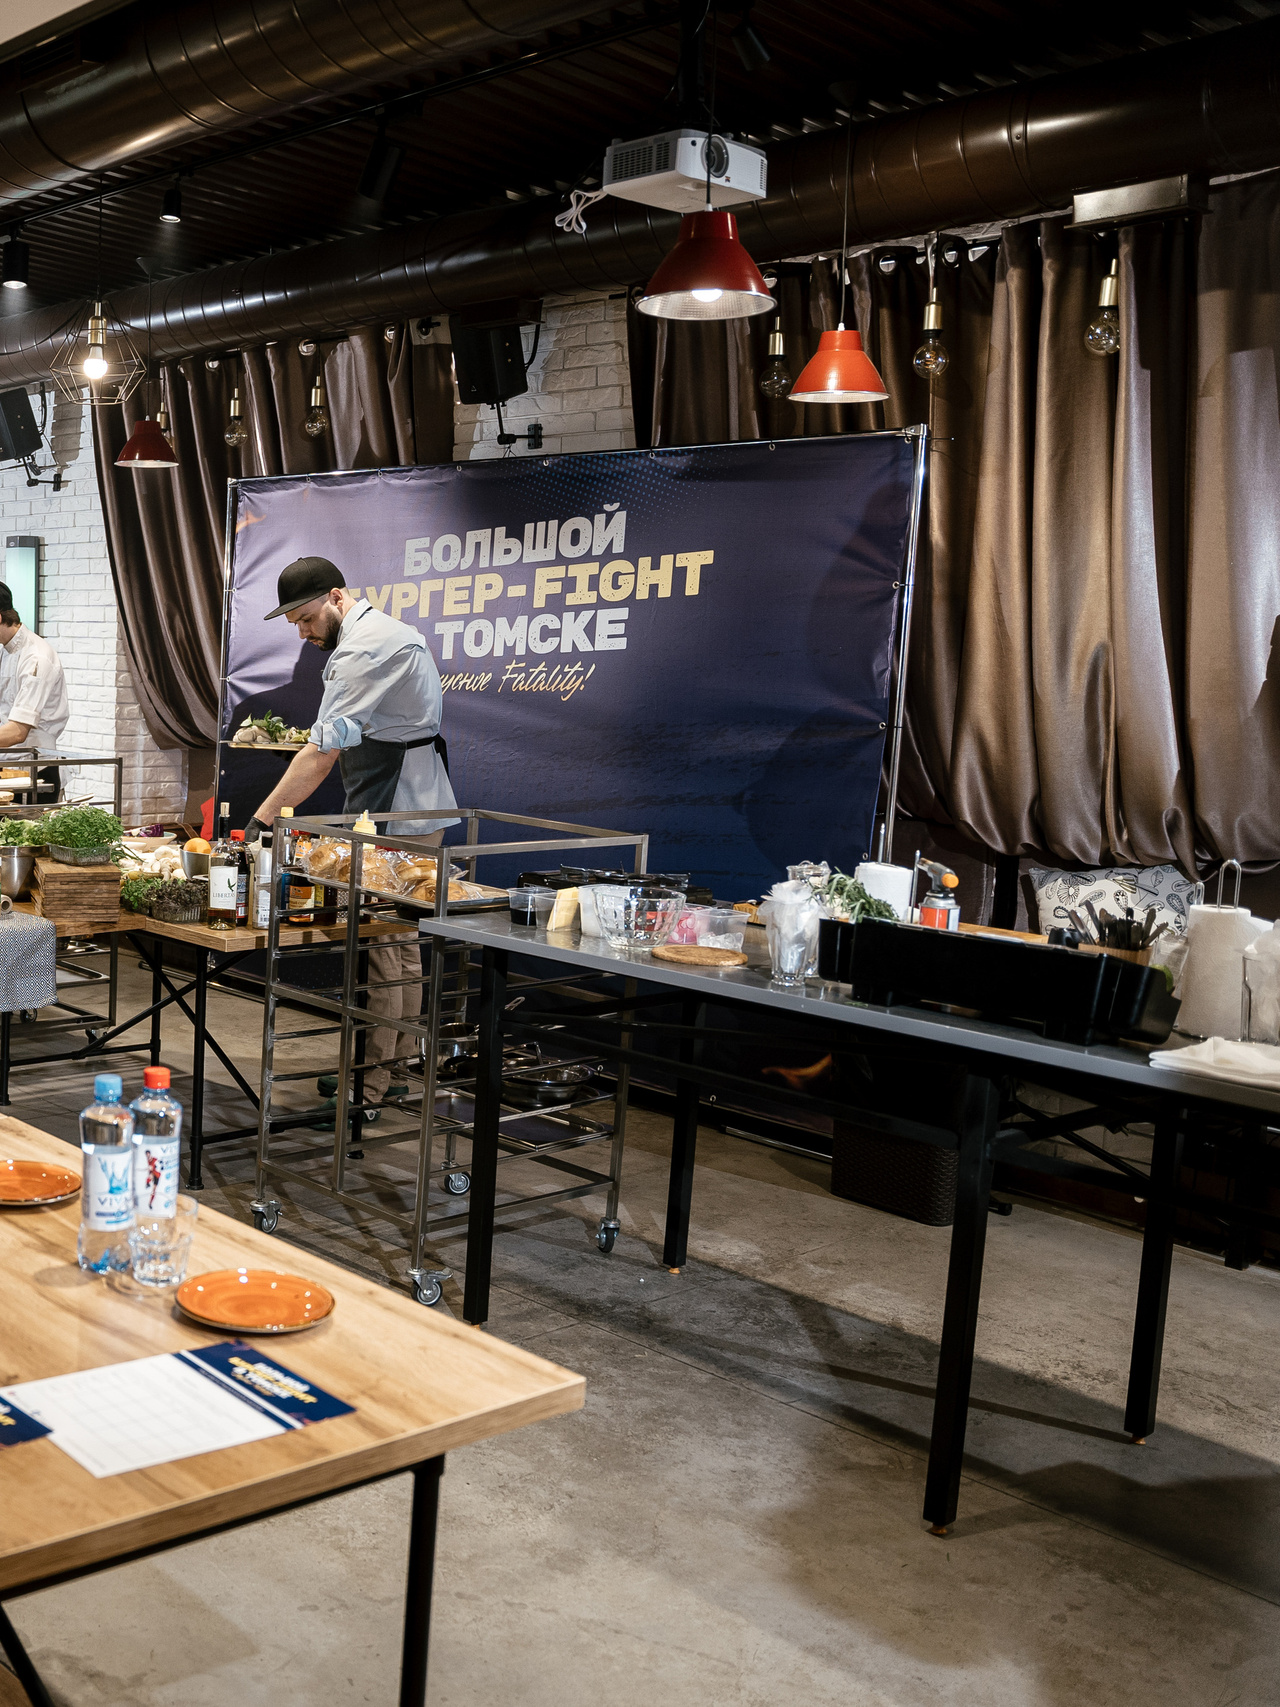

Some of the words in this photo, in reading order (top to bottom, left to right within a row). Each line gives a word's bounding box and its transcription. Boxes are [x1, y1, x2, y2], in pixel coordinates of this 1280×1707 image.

[403, 502, 627, 577] БОЛЬШОЙ
[348, 549, 714, 620] УРГЕР-FIGHT
[434, 607, 630, 660] ТОМСКЕ
[440, 671, 493, 696] усное
[497, 658, 596, 701] Fatality!
